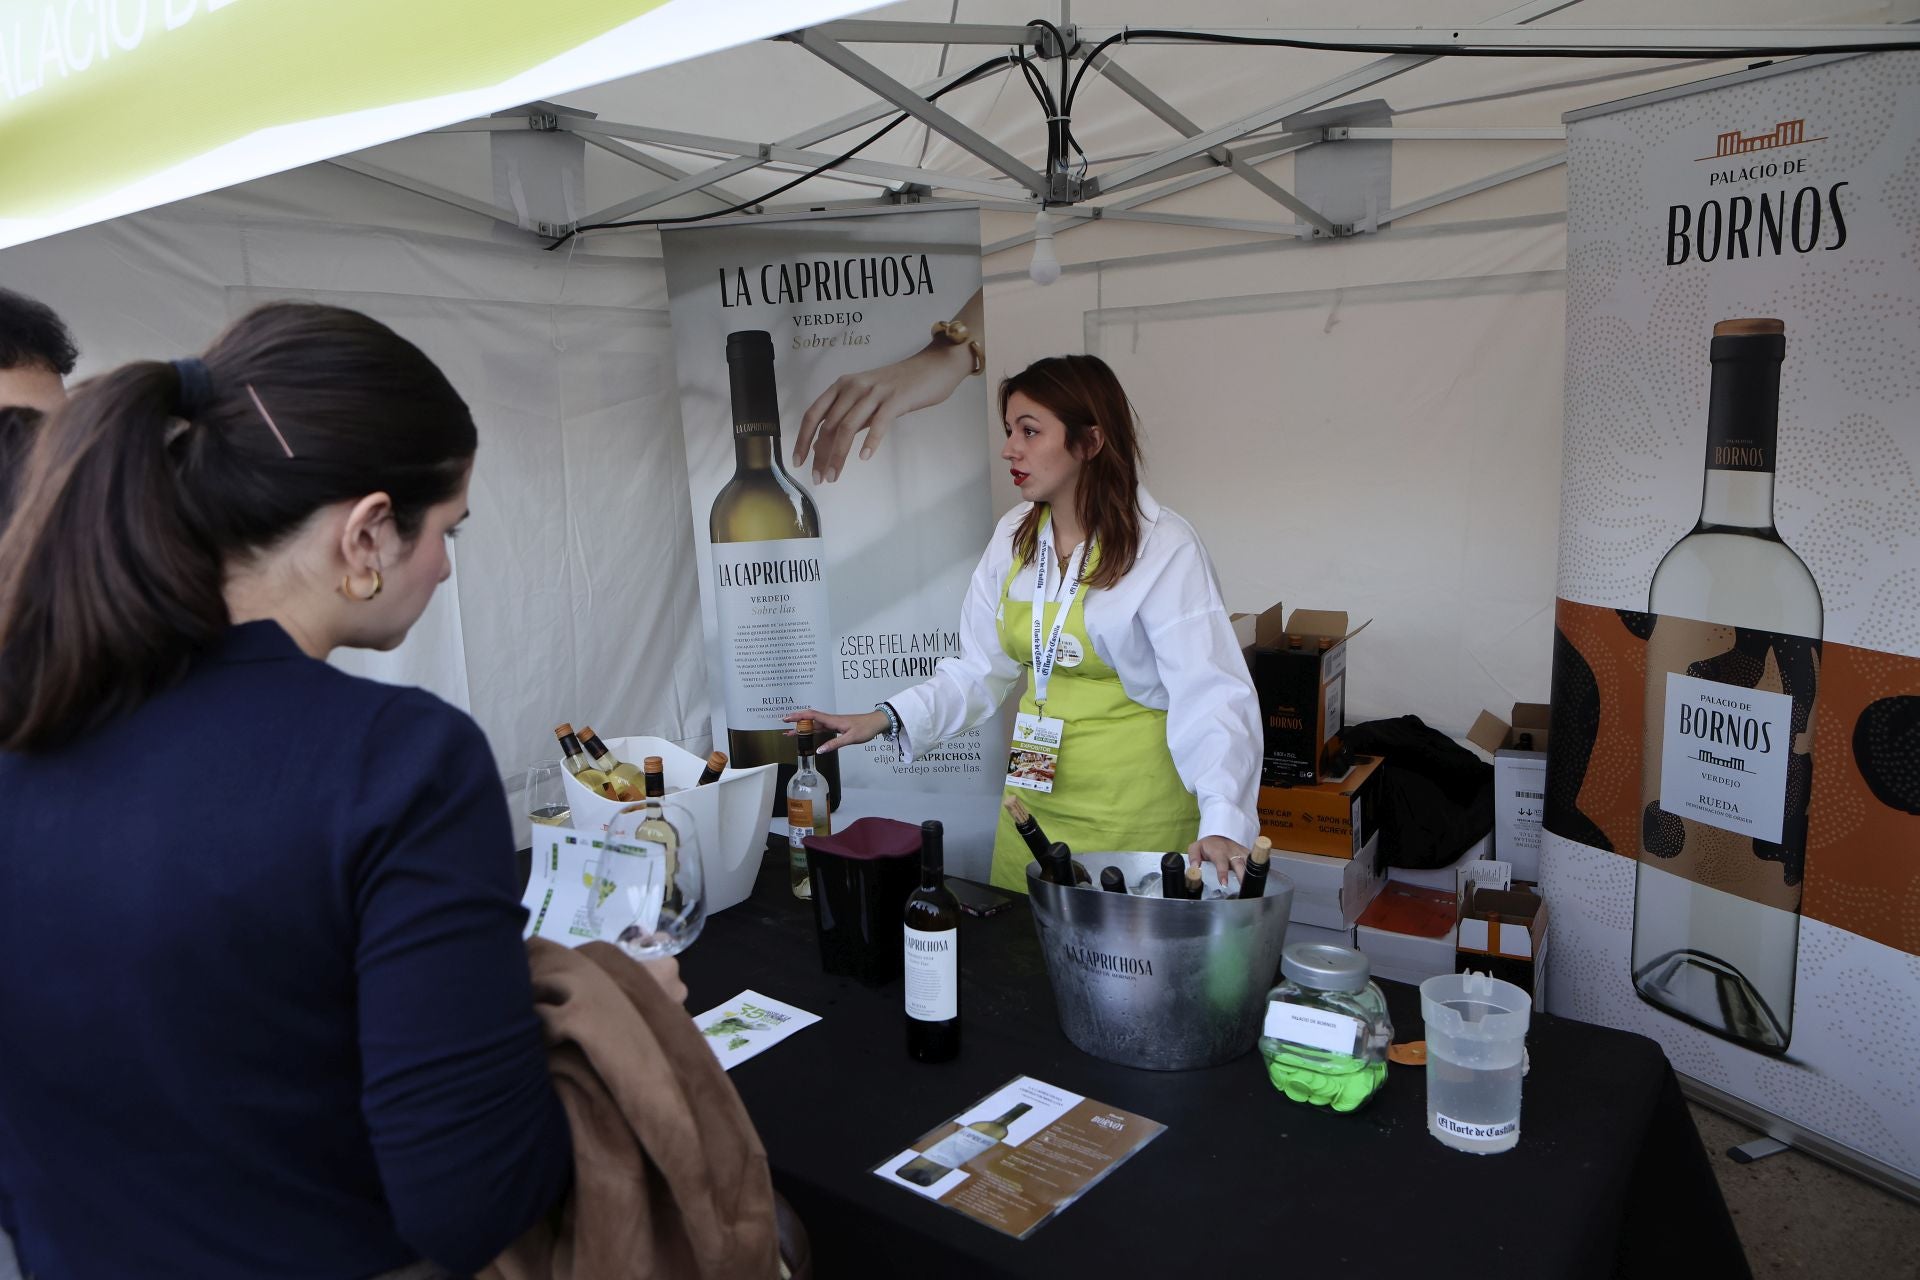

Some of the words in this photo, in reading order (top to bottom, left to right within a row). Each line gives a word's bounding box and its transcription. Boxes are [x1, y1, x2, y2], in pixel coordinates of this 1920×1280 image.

[1709, 163, 1778, 186] PALACIO
[1783, 158, 1808, 175] DE
[1666, 181, 1849, 266] BORNOS
[719, 267, 752, 308] LA
[760, 254, 934, 305] CAPRICHOSA
[792, 311, 863, 327] VERDEJO
[792, 332, 837, 350] Sobre
[842, 330, 871, 346] lías
[1715, 446, 1765, 468] BORNOS
[719, 564, 731, 587] LA
[735, 558, 820, 587] CAPRICHOSA
[751, 594, 790, 603] VERDEJO
[752, 606, 777, 615] Sobre
[840, 635, 875, 656] ¿SER
[879, 633, 907, 654] FIEL
[910, 633, 920, 653] A
[923, 628, 939, 652] MÍ
[944, 631, 960, 652] MI
[842, 660, 859, 680] ES
[862, 659, 890, 679] SER
[762, 696, 794, 705] RUEDA
[1700, 694, 1737, 709] PALACIO
[1739, 702, 1752, 711] DE
[1270, 715, 1303, 731] BORNOS
[1680, 703, 1772, 754] BORNOS
[968, 743, 981, 754] yo
[874, 755, 895, 764] elijo
[917, 752, 981, 762] APRICHOSA
[893, 764, 929, 775] Verdejo
[932, 762, 961, 774] sobre
[1701, 772, 1741, 788] VERDEJO
[1685, 801, 1725, 816] DENOMINACIÓN
[1699, 794, 1739, 813] RUEDA
[1276, 810, 1292, 818] CAP
[1270, 819, 1294, 828] ROSCA
[1079, 948, 1153, 976] CAPRICHOSA
[1291, 1015, 1309, 1023] PALACIO
[1316, 1020, 1337, 1029] BORNOS
[1438, 1117, 1448, 1129] El
[1449, 1121, 1474, 1136] Norte
[1475, 1127, 1484, 1137] de
[1486, 1123, 1516, 1137] Castilla
